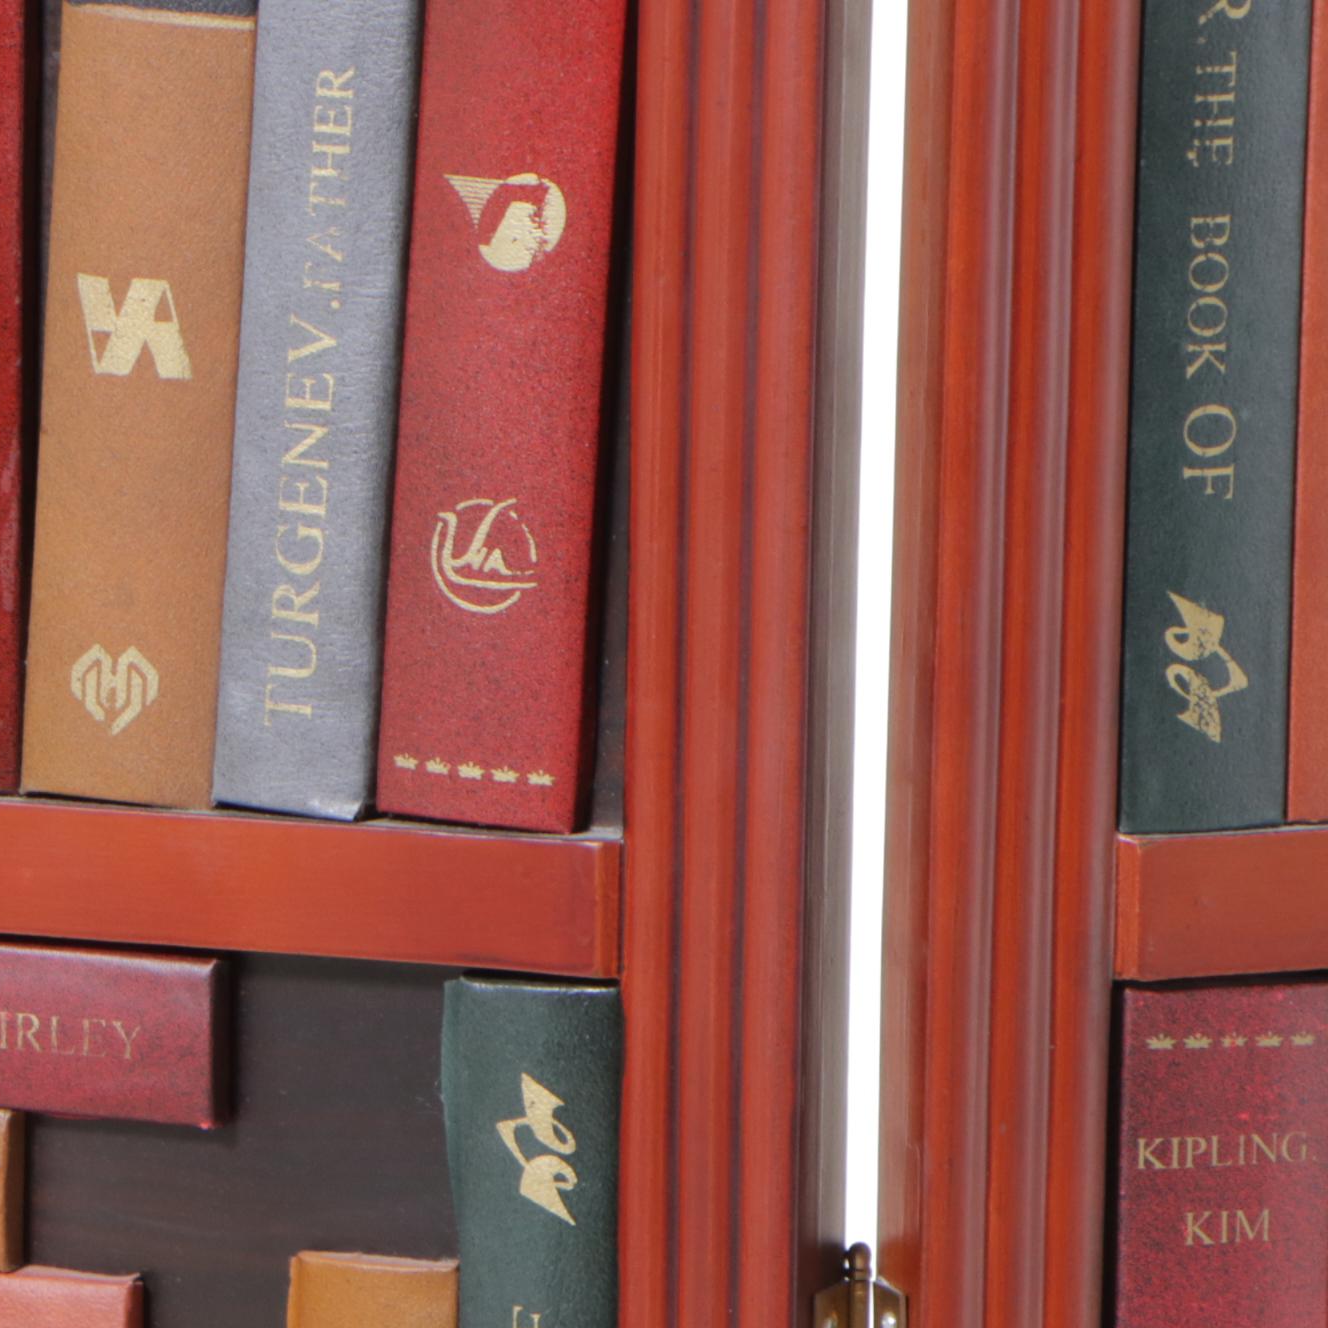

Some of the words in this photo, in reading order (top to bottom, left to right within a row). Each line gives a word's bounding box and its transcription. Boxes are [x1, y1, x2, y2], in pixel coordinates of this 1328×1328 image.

[1186, 213, 1231, 379] BOOK
[1181, 404, 1237, 500] OF
[1184, 1207, 1270, 1246] KIM
